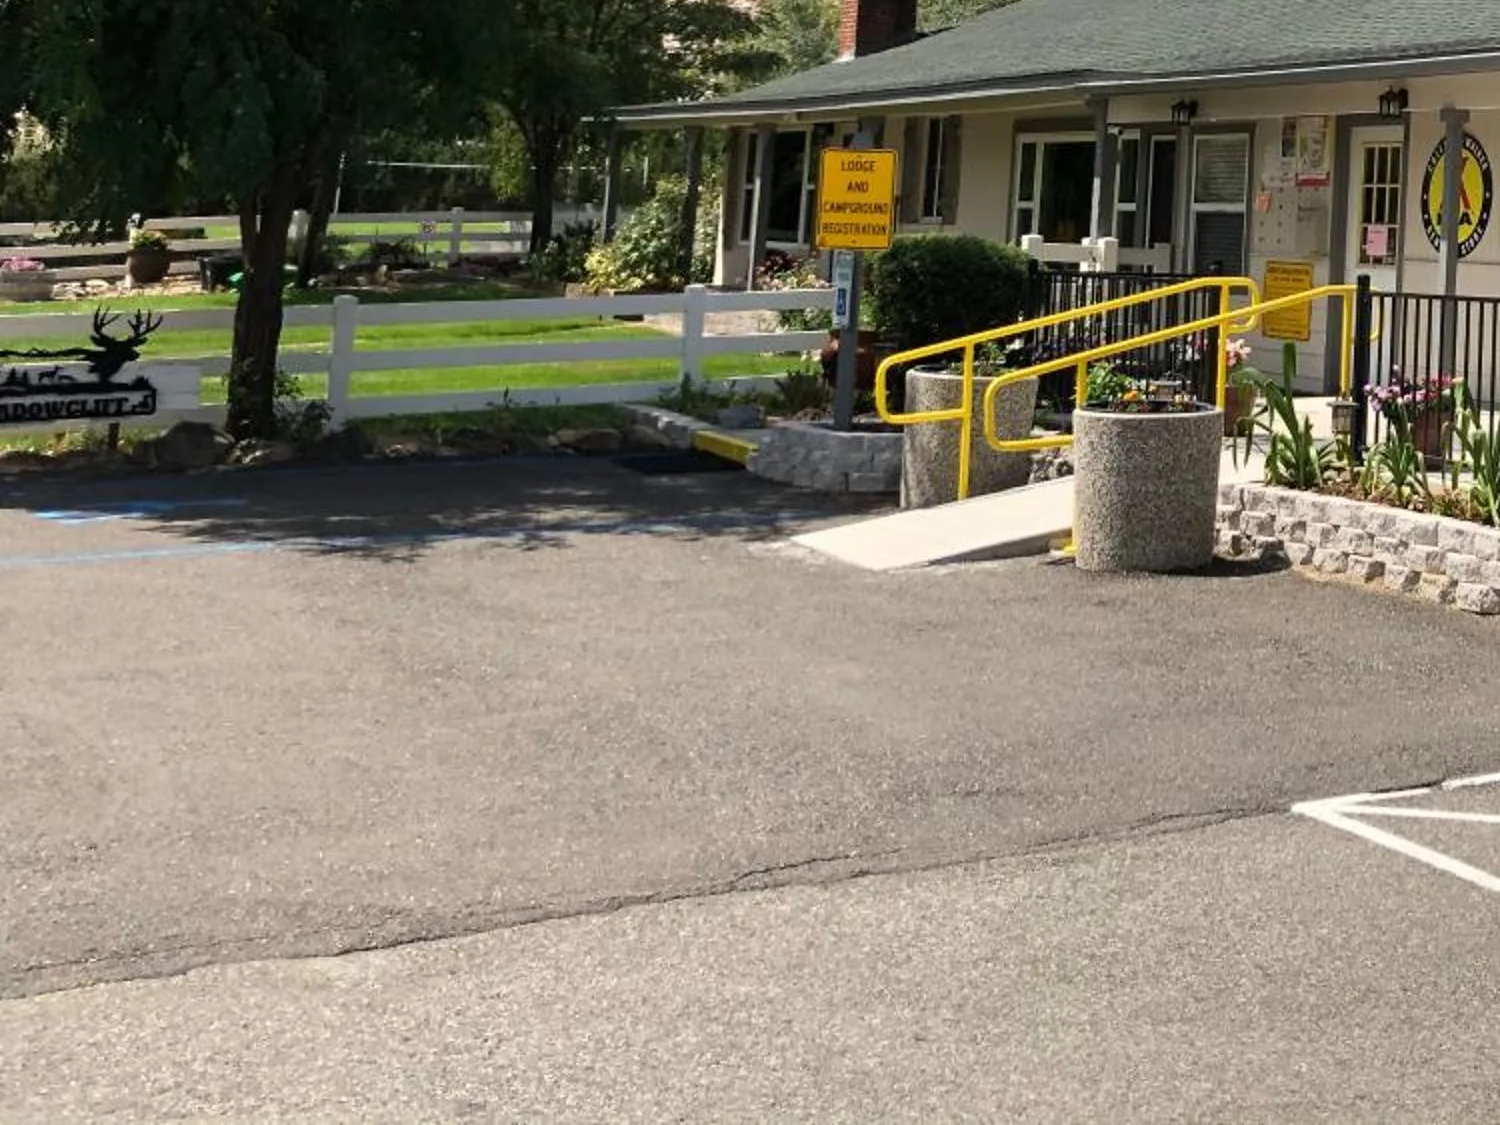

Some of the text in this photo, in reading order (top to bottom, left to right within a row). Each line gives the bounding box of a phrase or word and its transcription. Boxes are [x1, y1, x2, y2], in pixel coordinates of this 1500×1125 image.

[841, 160, 877, 172] LODGE
[847, 180, 869, 192] AND
[823, 201, 889, 214] CAMPGROUND
[822, 222, 887, 235] REGISTRATION
